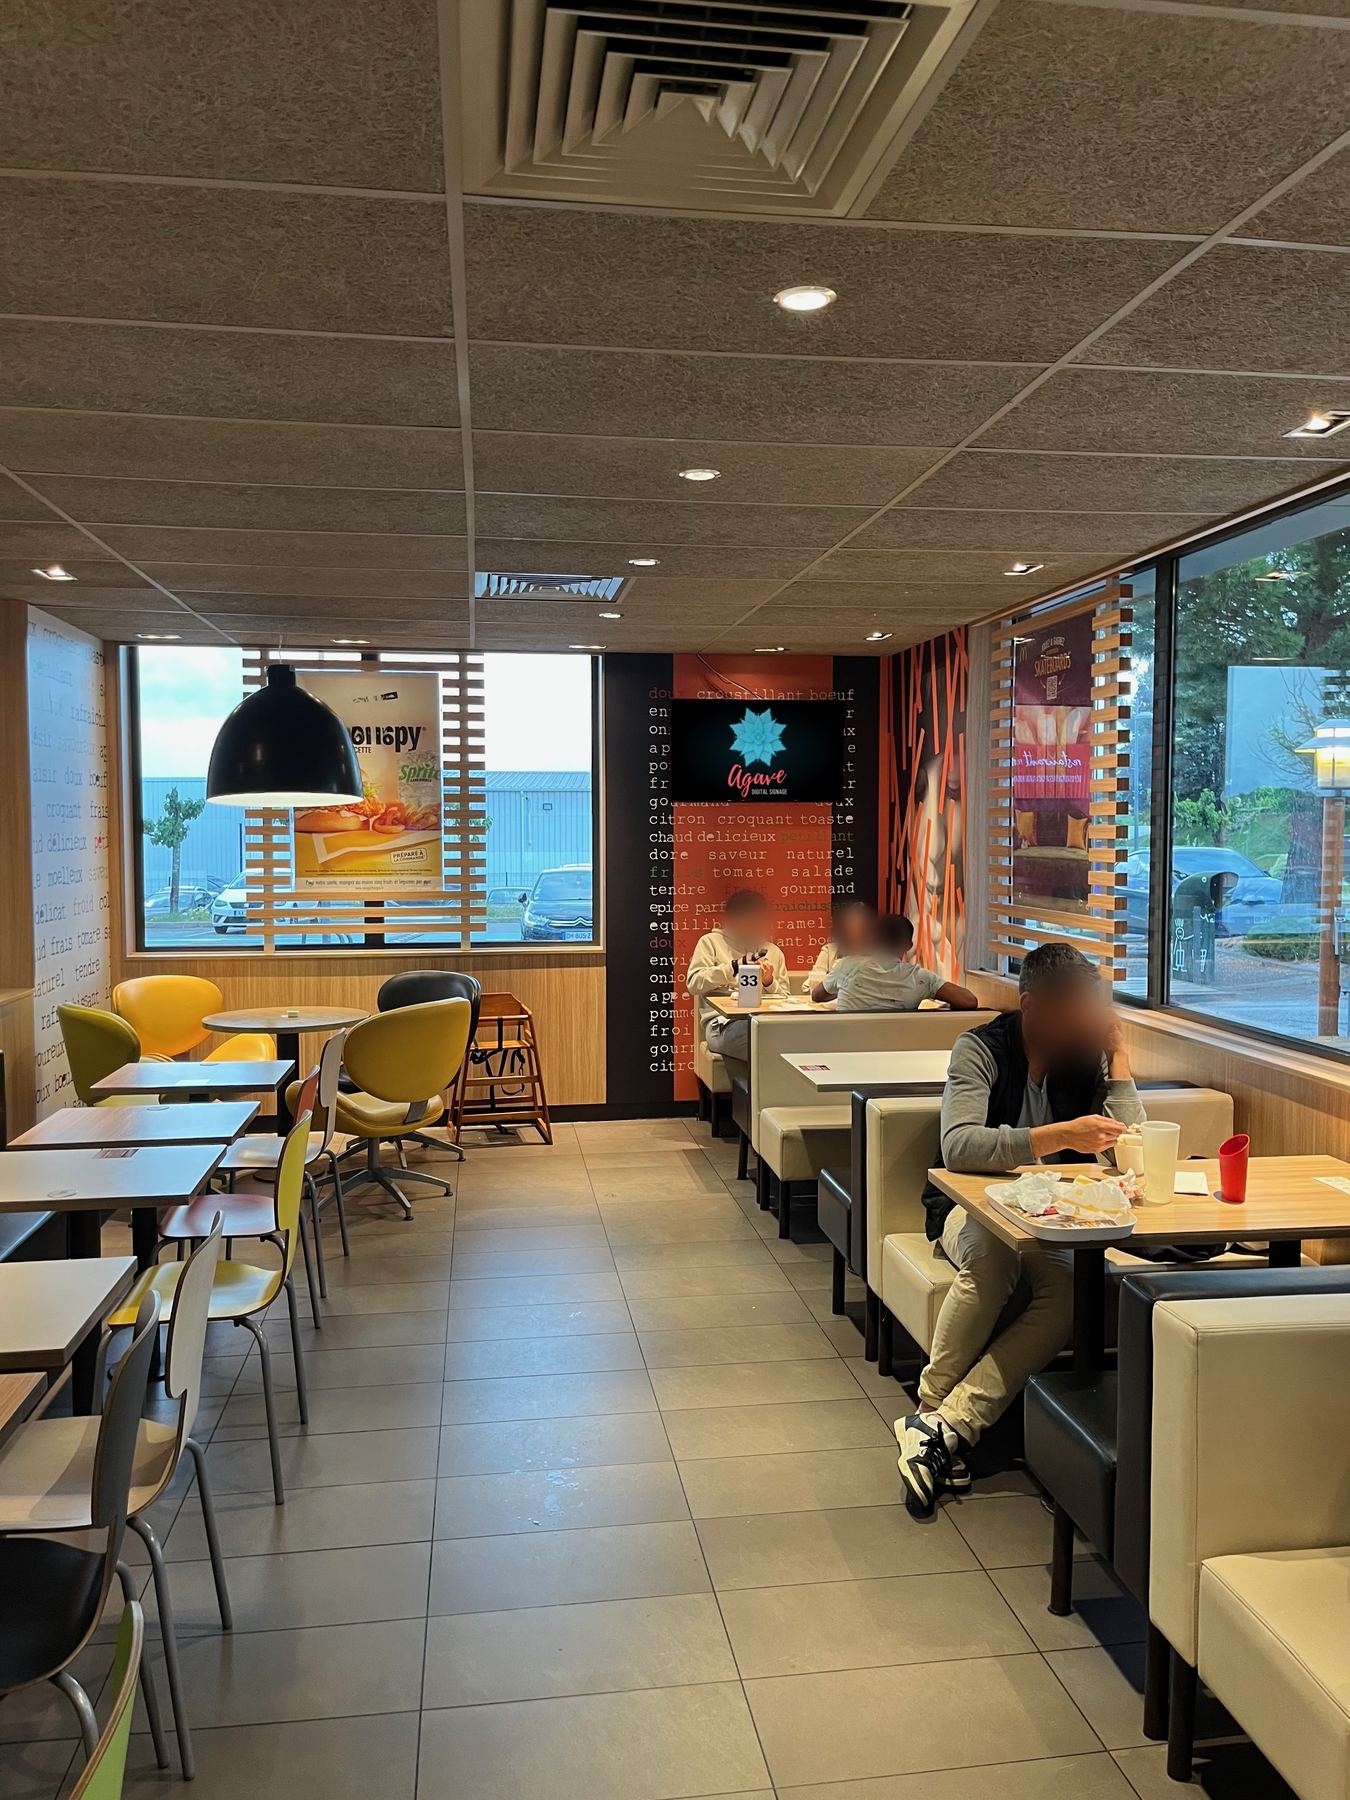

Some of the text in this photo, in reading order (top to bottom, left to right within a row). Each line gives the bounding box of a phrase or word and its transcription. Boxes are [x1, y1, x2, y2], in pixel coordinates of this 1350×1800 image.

[697, 688, 803, 700] croustillant
[809, 688, 855, 700] boeuf
[728, 763, 788, 798] Agave
[649, 812, 854, 827] citron croquant toaste
[649, 831, 693, 843] chaud
[697, 830, 776, 842] delicieux
[649, 848, 855, 860] dore saveur naturel
[712, 866, 775, 878] tomate
[791, 865, 854, 877] salade
[649, 884, 706, 896] tendre
[780, 883, 855, 898] gourmand
[649, 901, 689, 916] epice
[649, 953, 689, 966] envi
[649, 971, 686, 984] onio
[740, 975, 758, 987] 33
[649, 1024, 692, 1037] froi
